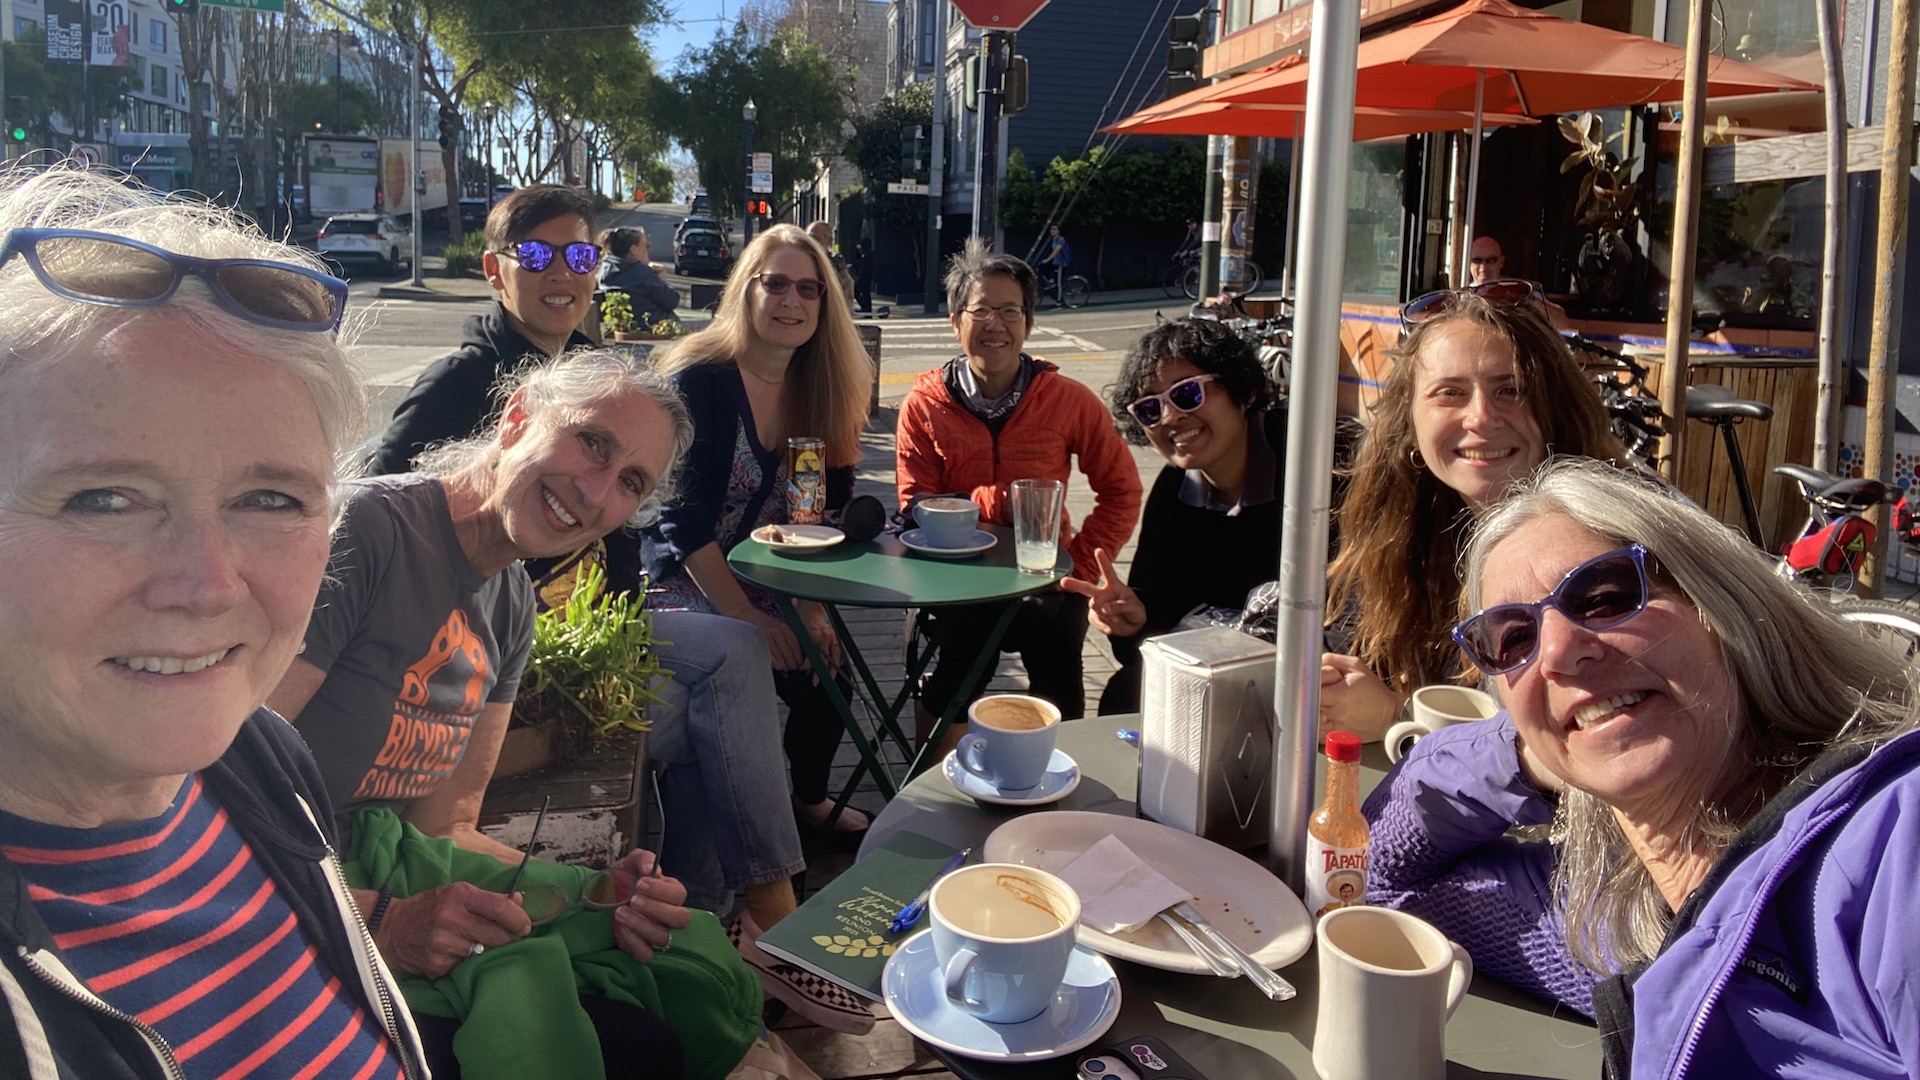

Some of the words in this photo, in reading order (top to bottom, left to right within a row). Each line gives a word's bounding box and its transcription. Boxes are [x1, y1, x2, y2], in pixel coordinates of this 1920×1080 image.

[47, 14, 59, 59] MUSEUM
[59, 27, 70, 59] CRAFT
[70, 22, 82, 60] DESIGN
[374, 713, 470, 772] BICYCLE
[835, 914, 877, 936] REUNION
[851, 915, 872, 926] AND
[1741, 956, 1797, 993] tagonia
